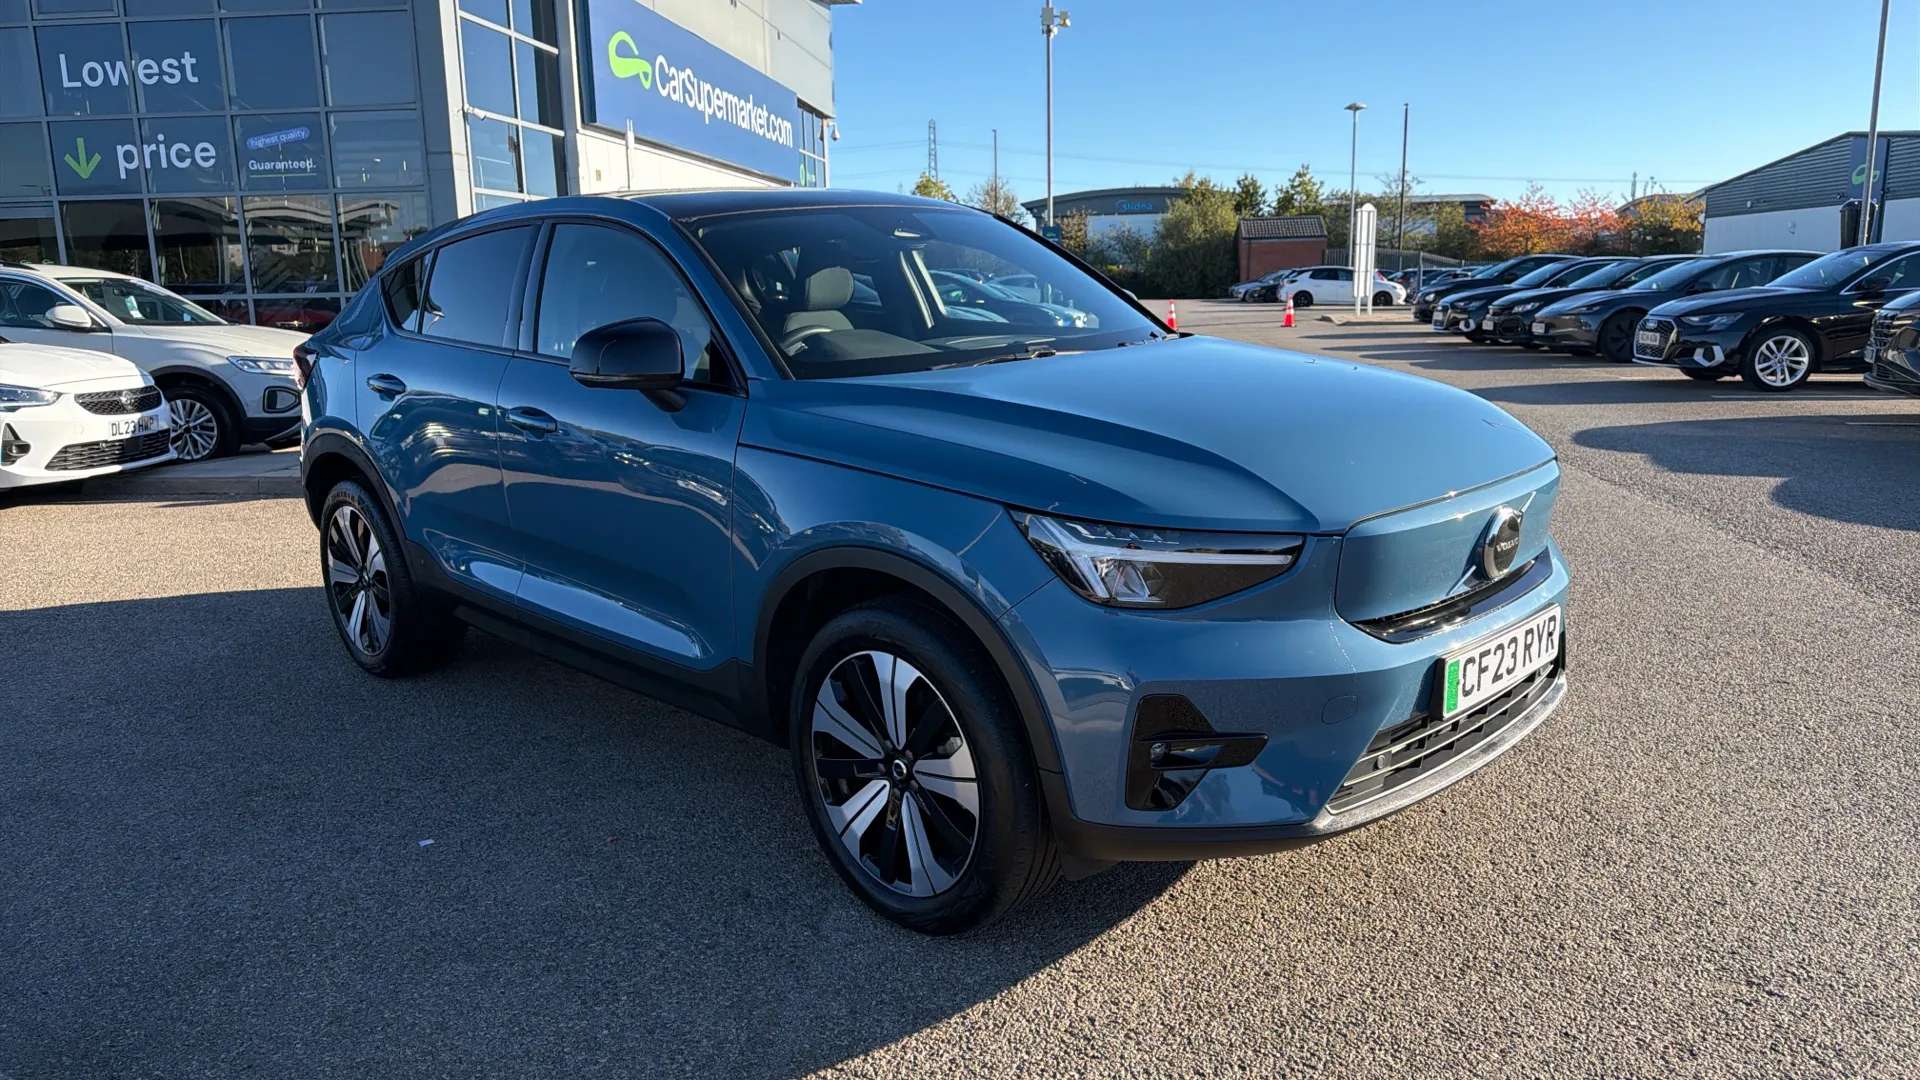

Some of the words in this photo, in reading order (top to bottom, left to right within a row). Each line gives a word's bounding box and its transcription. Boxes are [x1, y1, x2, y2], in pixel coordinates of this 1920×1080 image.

[58, 51, 199, 88] Lowest
[655, 54, 793, 148] CarSupermarket.com
[116, 134, 216, 179] price
[1462, 636, 1518, 697] CF23
[1522, 614, 1557, 668] RYR
